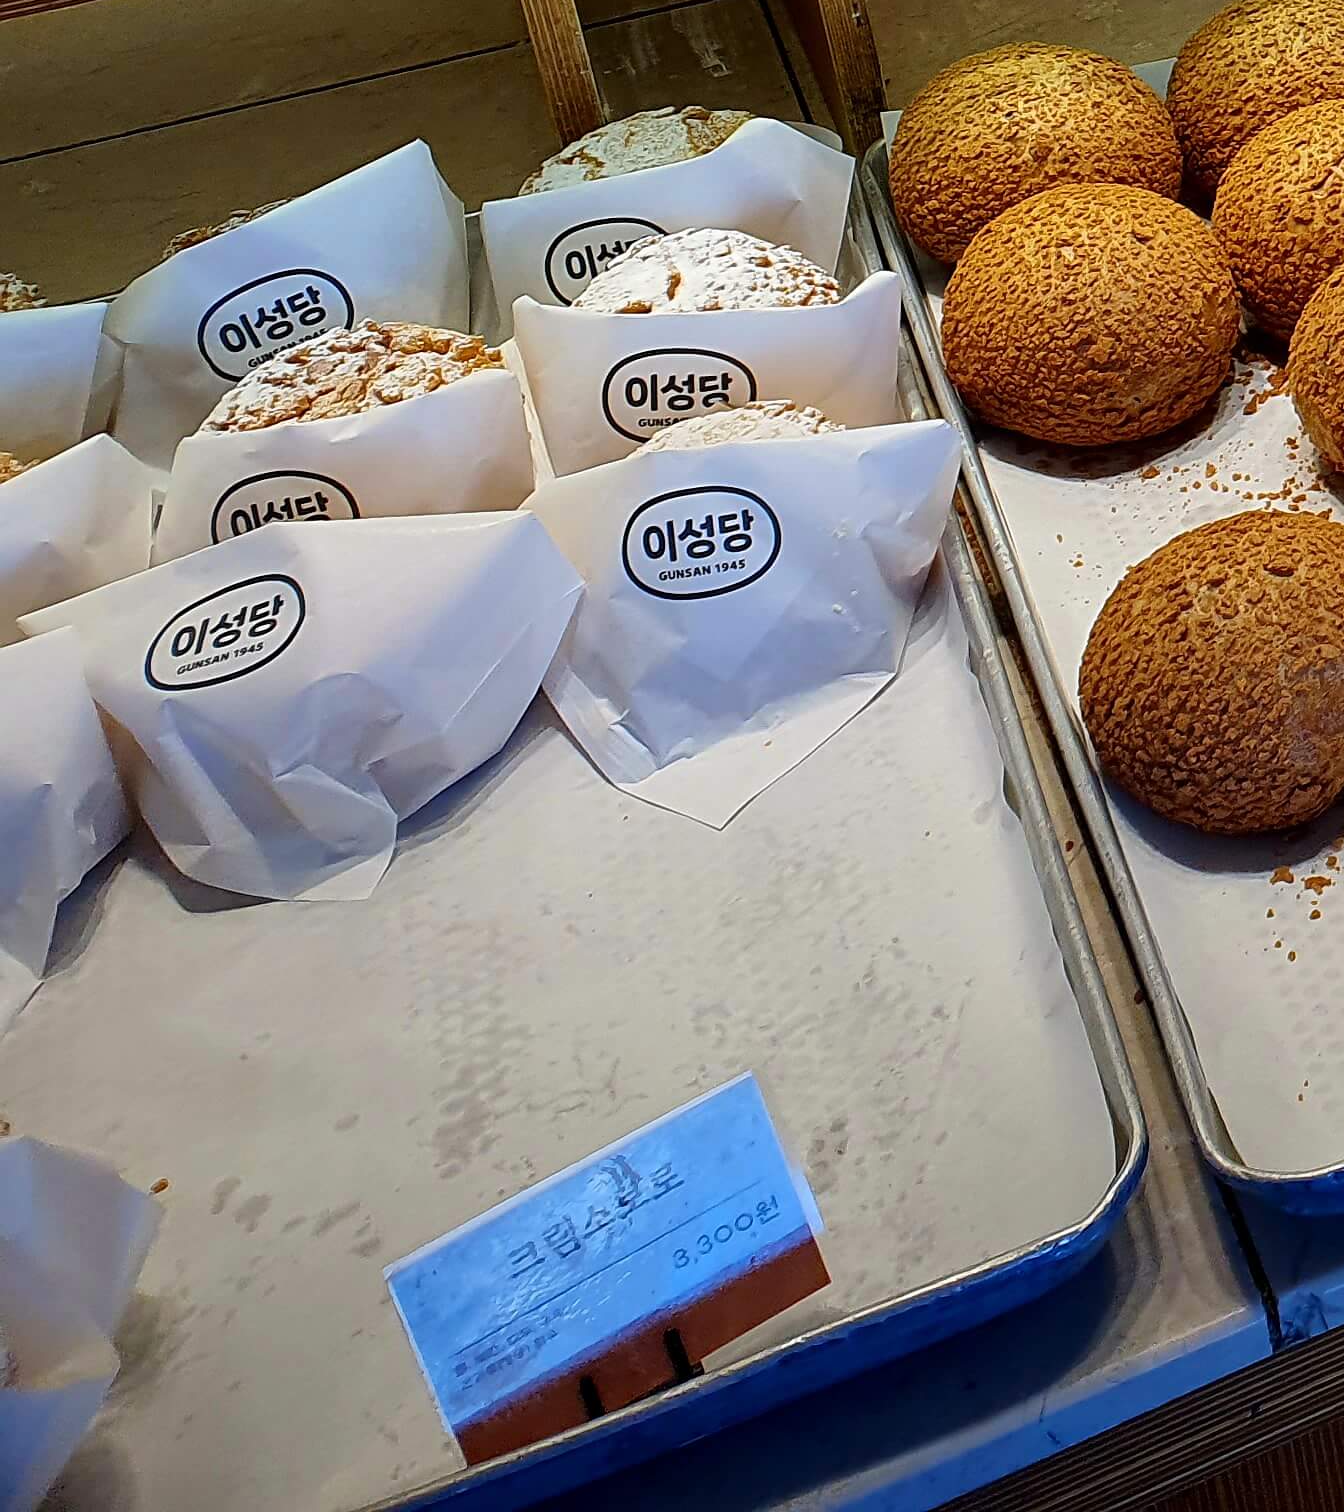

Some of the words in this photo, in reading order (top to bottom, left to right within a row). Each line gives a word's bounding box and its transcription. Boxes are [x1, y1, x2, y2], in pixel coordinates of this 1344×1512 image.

[219, 285, 327, 353] 이성당
[625, 372, 733, 412] 이성당
[638, 417, 690, 428] GUNSA
[642, 509, 755, 562] 이성당
[658, 565, 712, 581] GUNSAN
[714, 559, 746, 573] 1945
[171, 594, 285, 658] 이성당
[176, 652, 230, 675] GUNSAN
[233, 642, 264, 658] 1945
[673, 1194, 781, 1270] 3,300원
